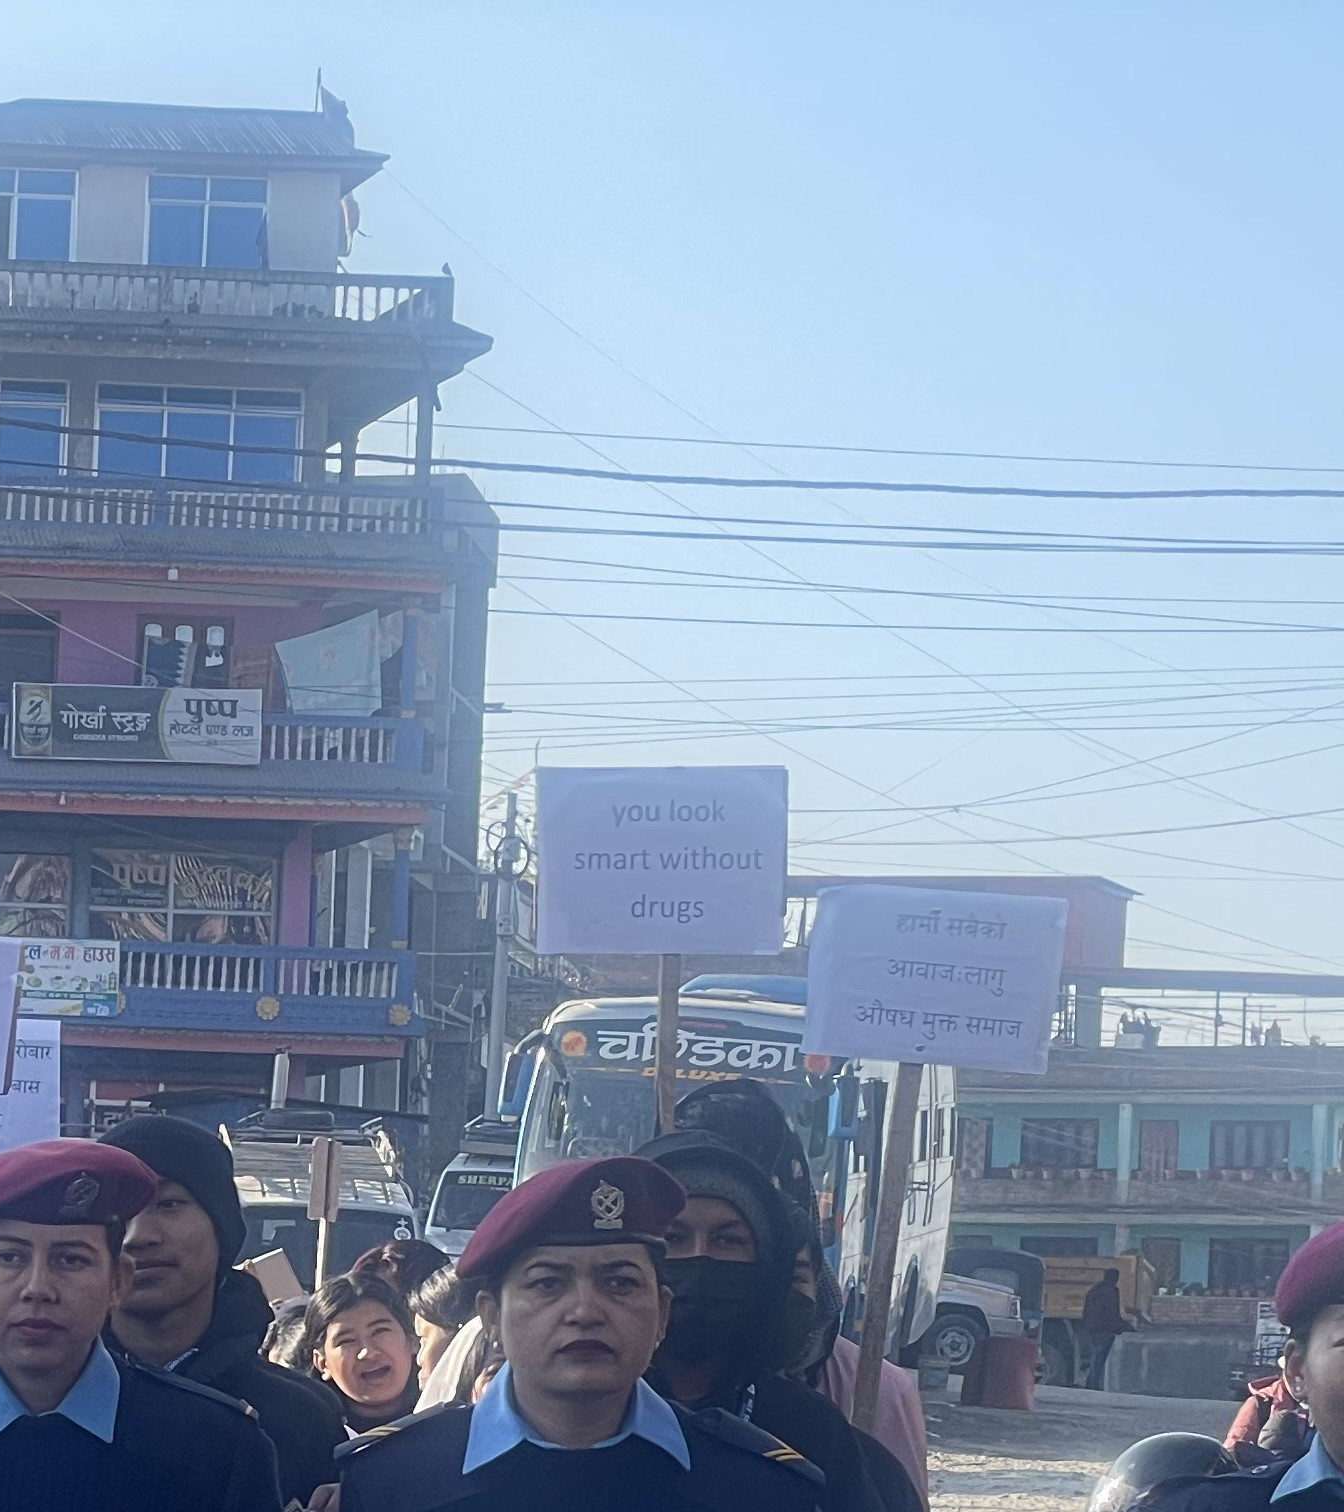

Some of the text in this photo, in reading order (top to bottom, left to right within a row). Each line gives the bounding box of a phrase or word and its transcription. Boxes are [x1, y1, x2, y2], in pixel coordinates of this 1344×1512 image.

[60, 703, 106, 730] गोर्खा
[183, 698, 240, 724] पुष्प
[612, 798, 726, 828] you look
[573, 846, 764, 871] smart without
[630, 893, 705, 924] drugs
[83, 946, 117, 963] हाउस
[921, 1012, 961, 1041] मुक्त
[965, 1016, 1024, 1039] समाज
[14, 1038, 53, 1060] रोबार
[642, 1067, 743, 1081] DLUXE
[457, 1174, 513, 1187] SHERPA
